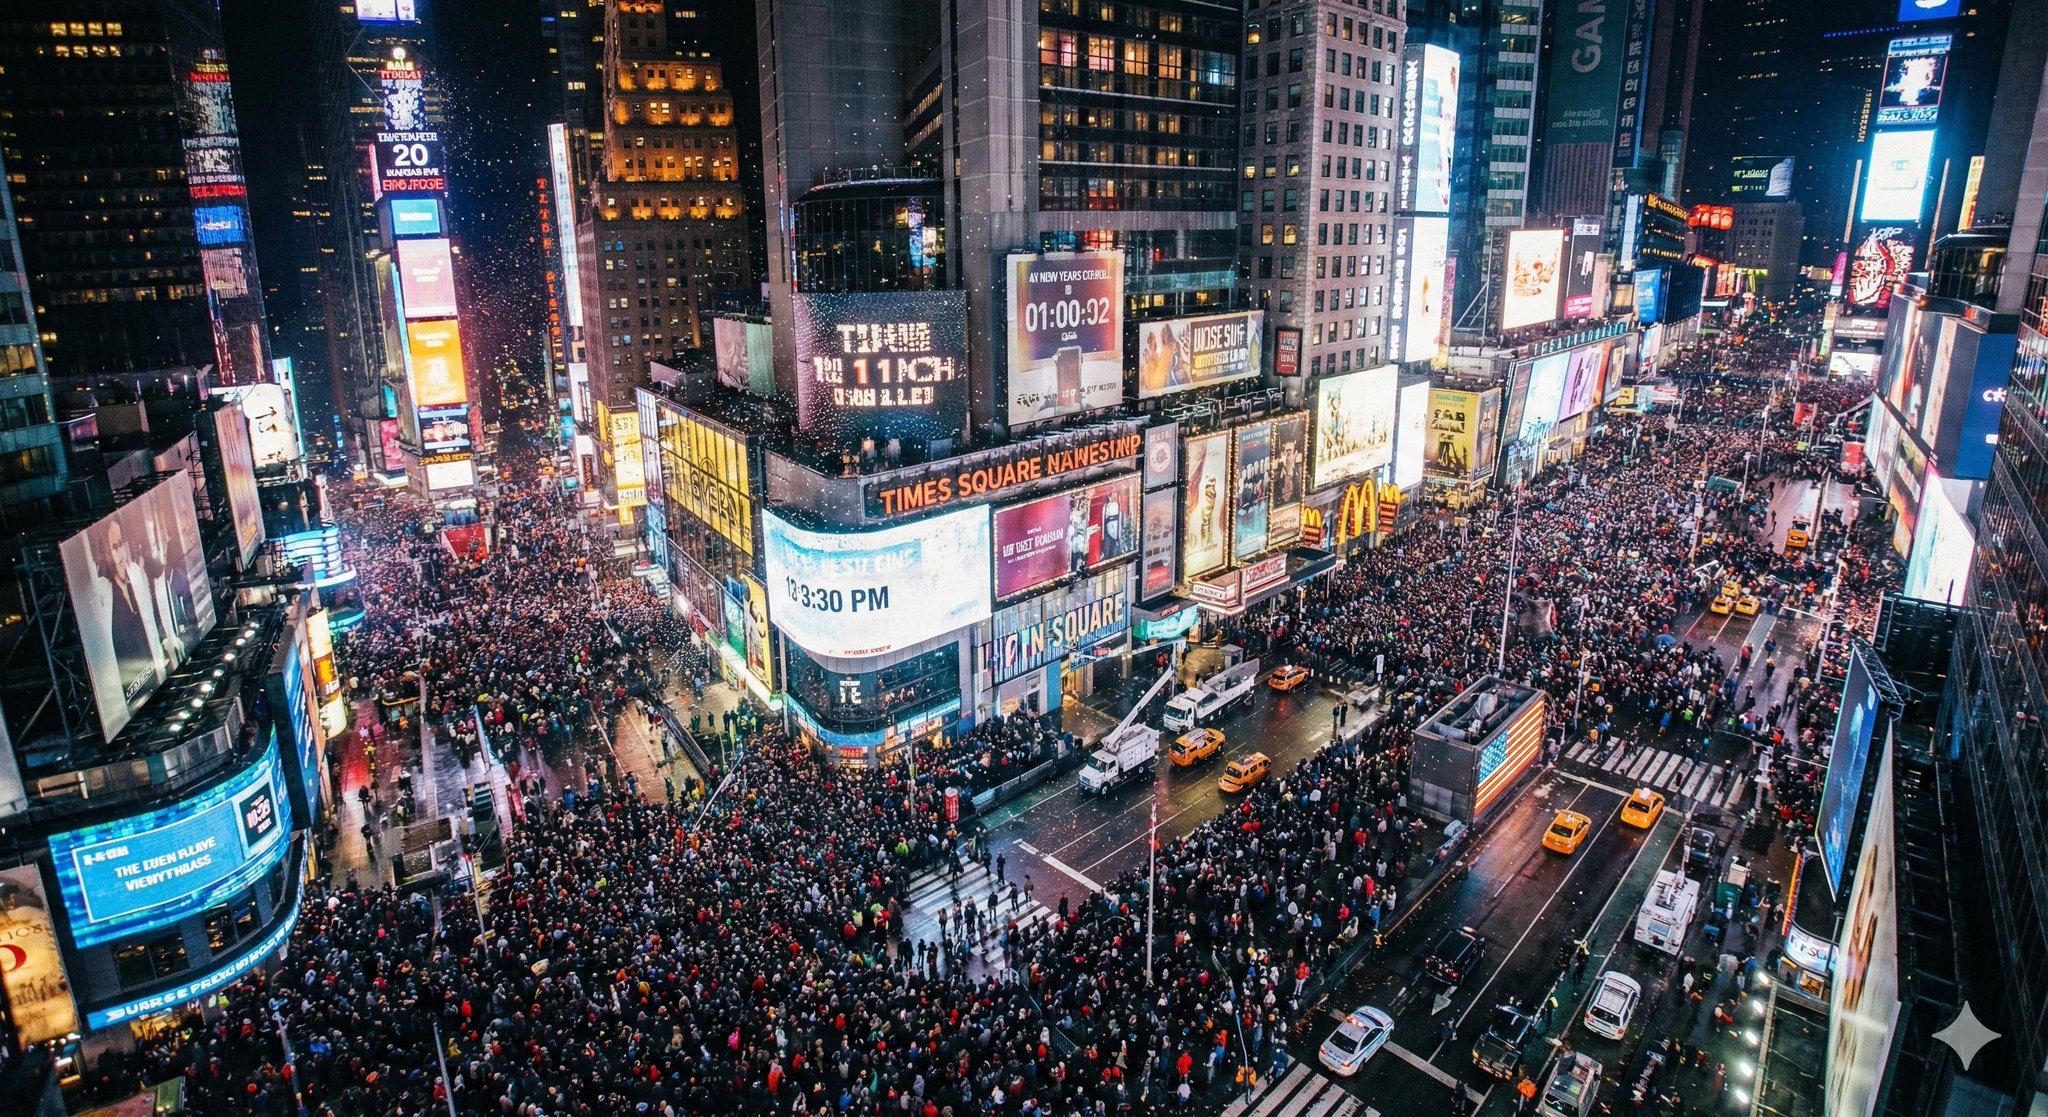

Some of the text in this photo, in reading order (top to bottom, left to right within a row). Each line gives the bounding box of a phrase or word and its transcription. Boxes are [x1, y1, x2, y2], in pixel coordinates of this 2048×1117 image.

[392, 143, 429, 167] 20
[1059, 270, 1081, 282] YEARS
[879, 478, 952, 515] TIMES
[957, 456, 1042, 497] SQUARE
[851, 585, 889, 613] PM
[1052, 591, 1125, 648] SQUARE
[114, 862, 142, 878] THE
